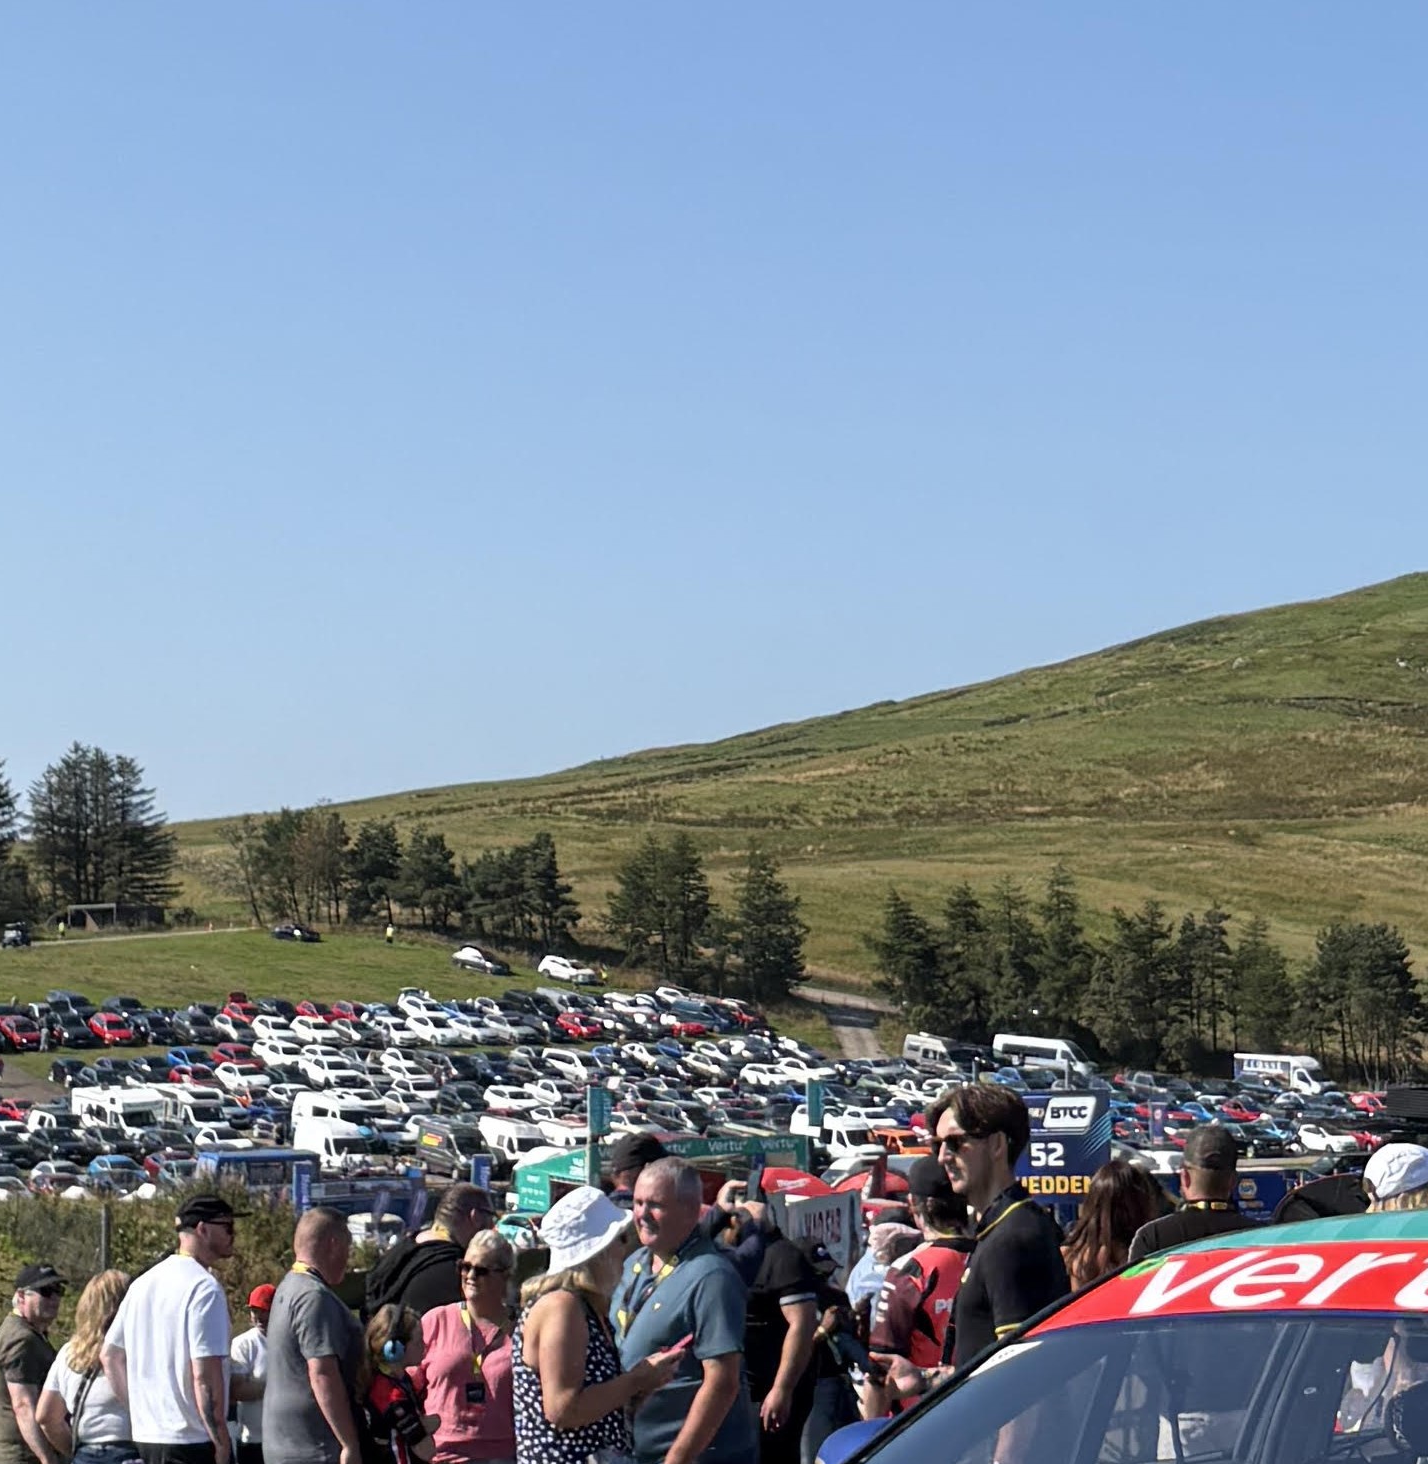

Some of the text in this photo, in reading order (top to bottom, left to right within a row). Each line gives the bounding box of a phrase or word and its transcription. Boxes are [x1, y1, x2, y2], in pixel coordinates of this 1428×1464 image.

[1050, 1105, 1088, 1119] BTCC
[1030, 1142, 1065, 1167] 52
[1016, 1175, 1091, 1194] EDDE
